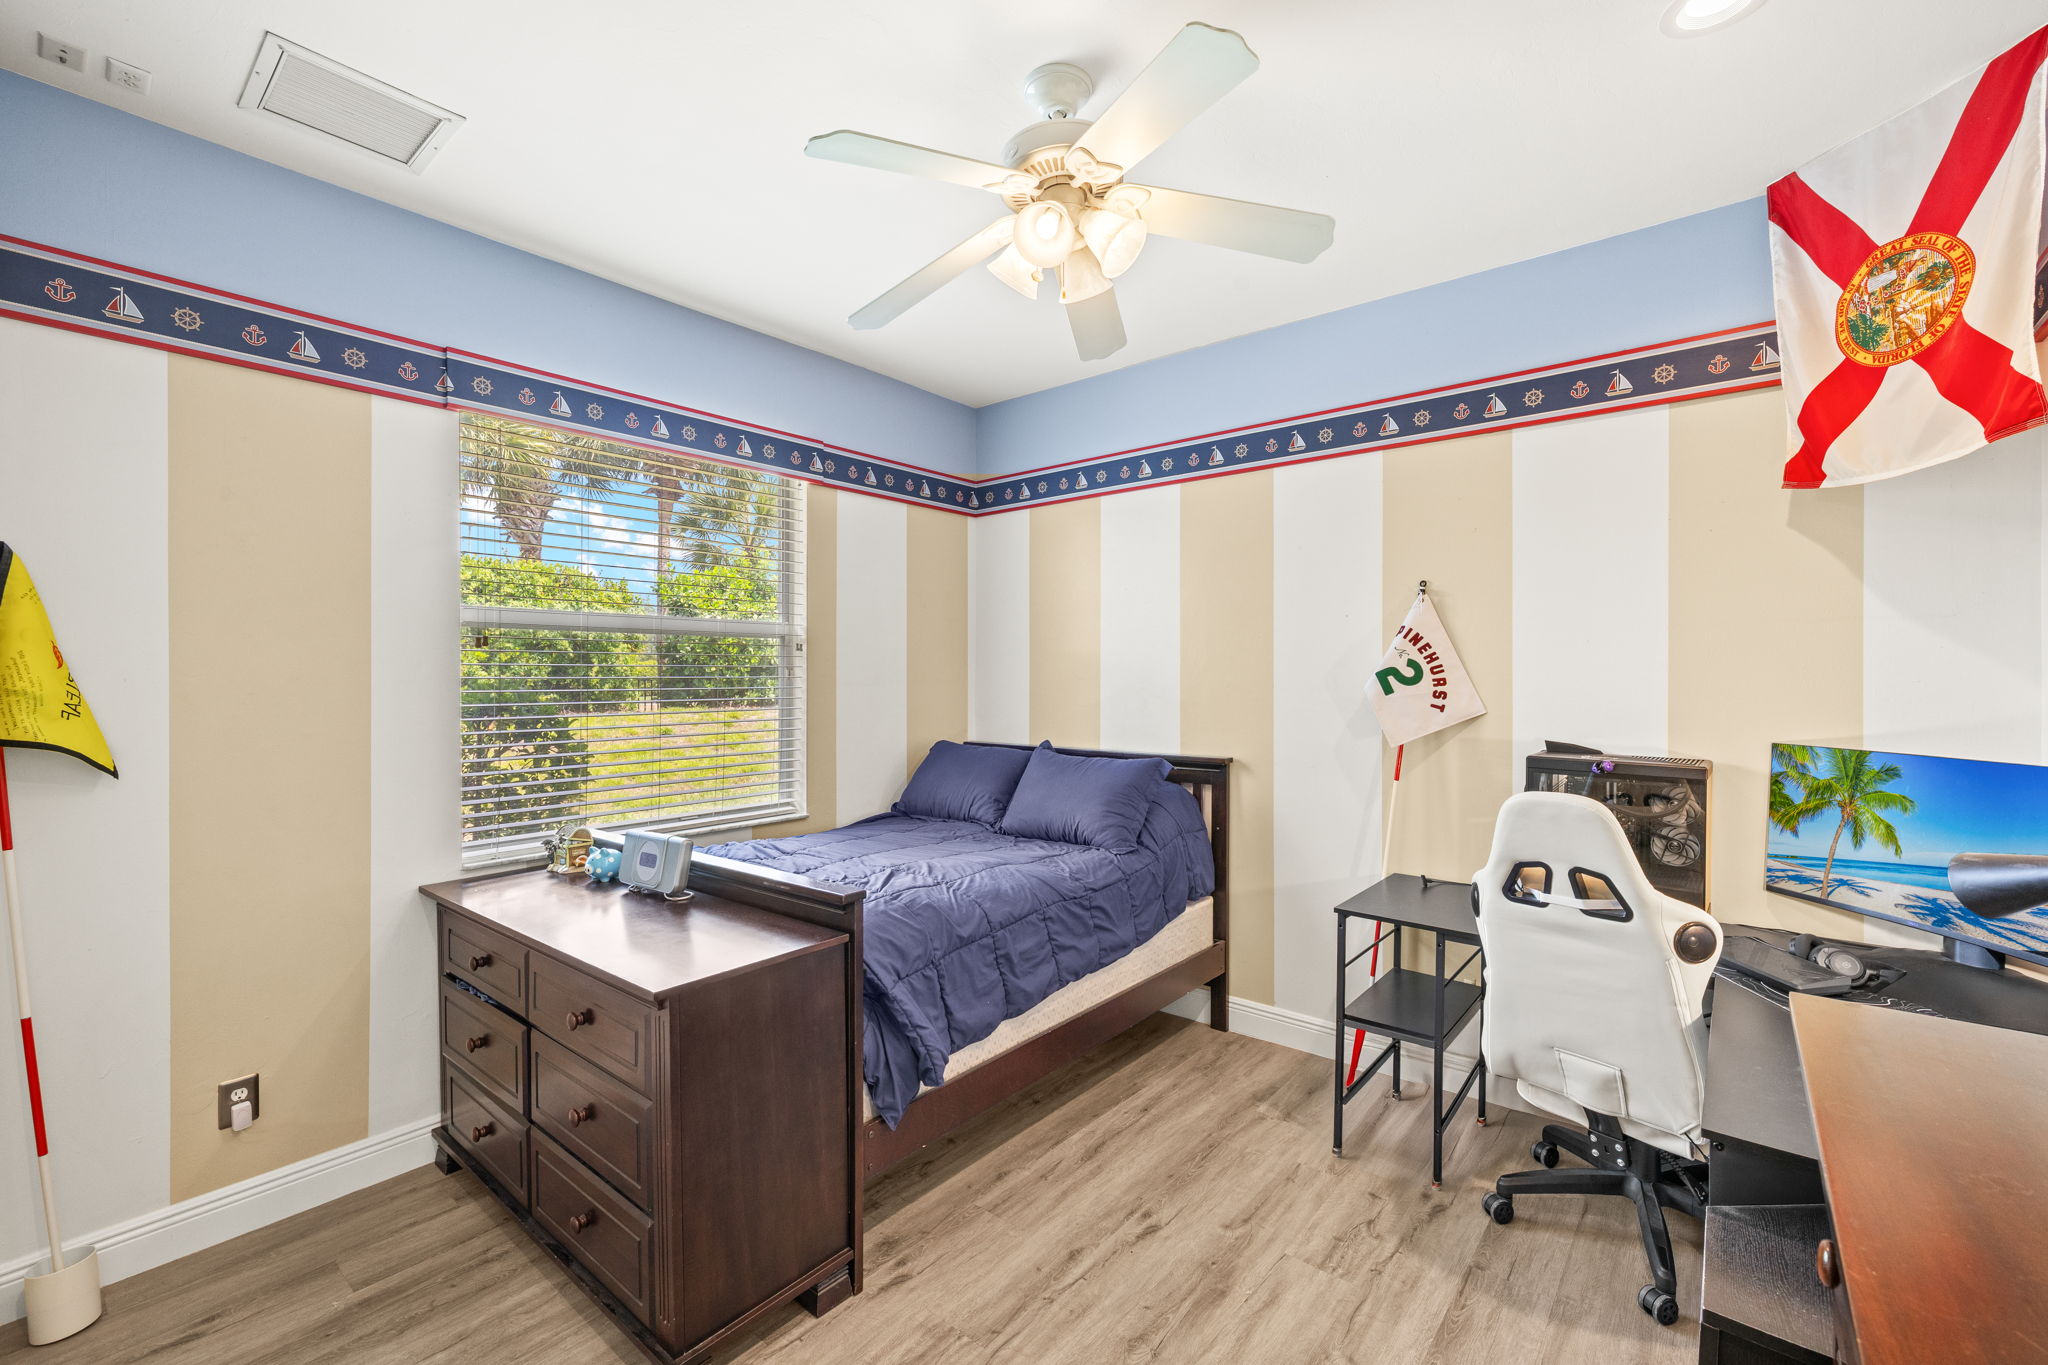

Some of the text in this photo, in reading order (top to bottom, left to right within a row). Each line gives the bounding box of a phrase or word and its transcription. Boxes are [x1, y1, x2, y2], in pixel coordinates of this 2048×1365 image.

[1838, 298, 1848, 317] GOD
[1865, 235, 1973, 364] GREAT SEAL OF THE STATE OF FLORIDA
[1841, 336, 1860, 357] TRUST
[1375, 658, 1423, 696] 2
